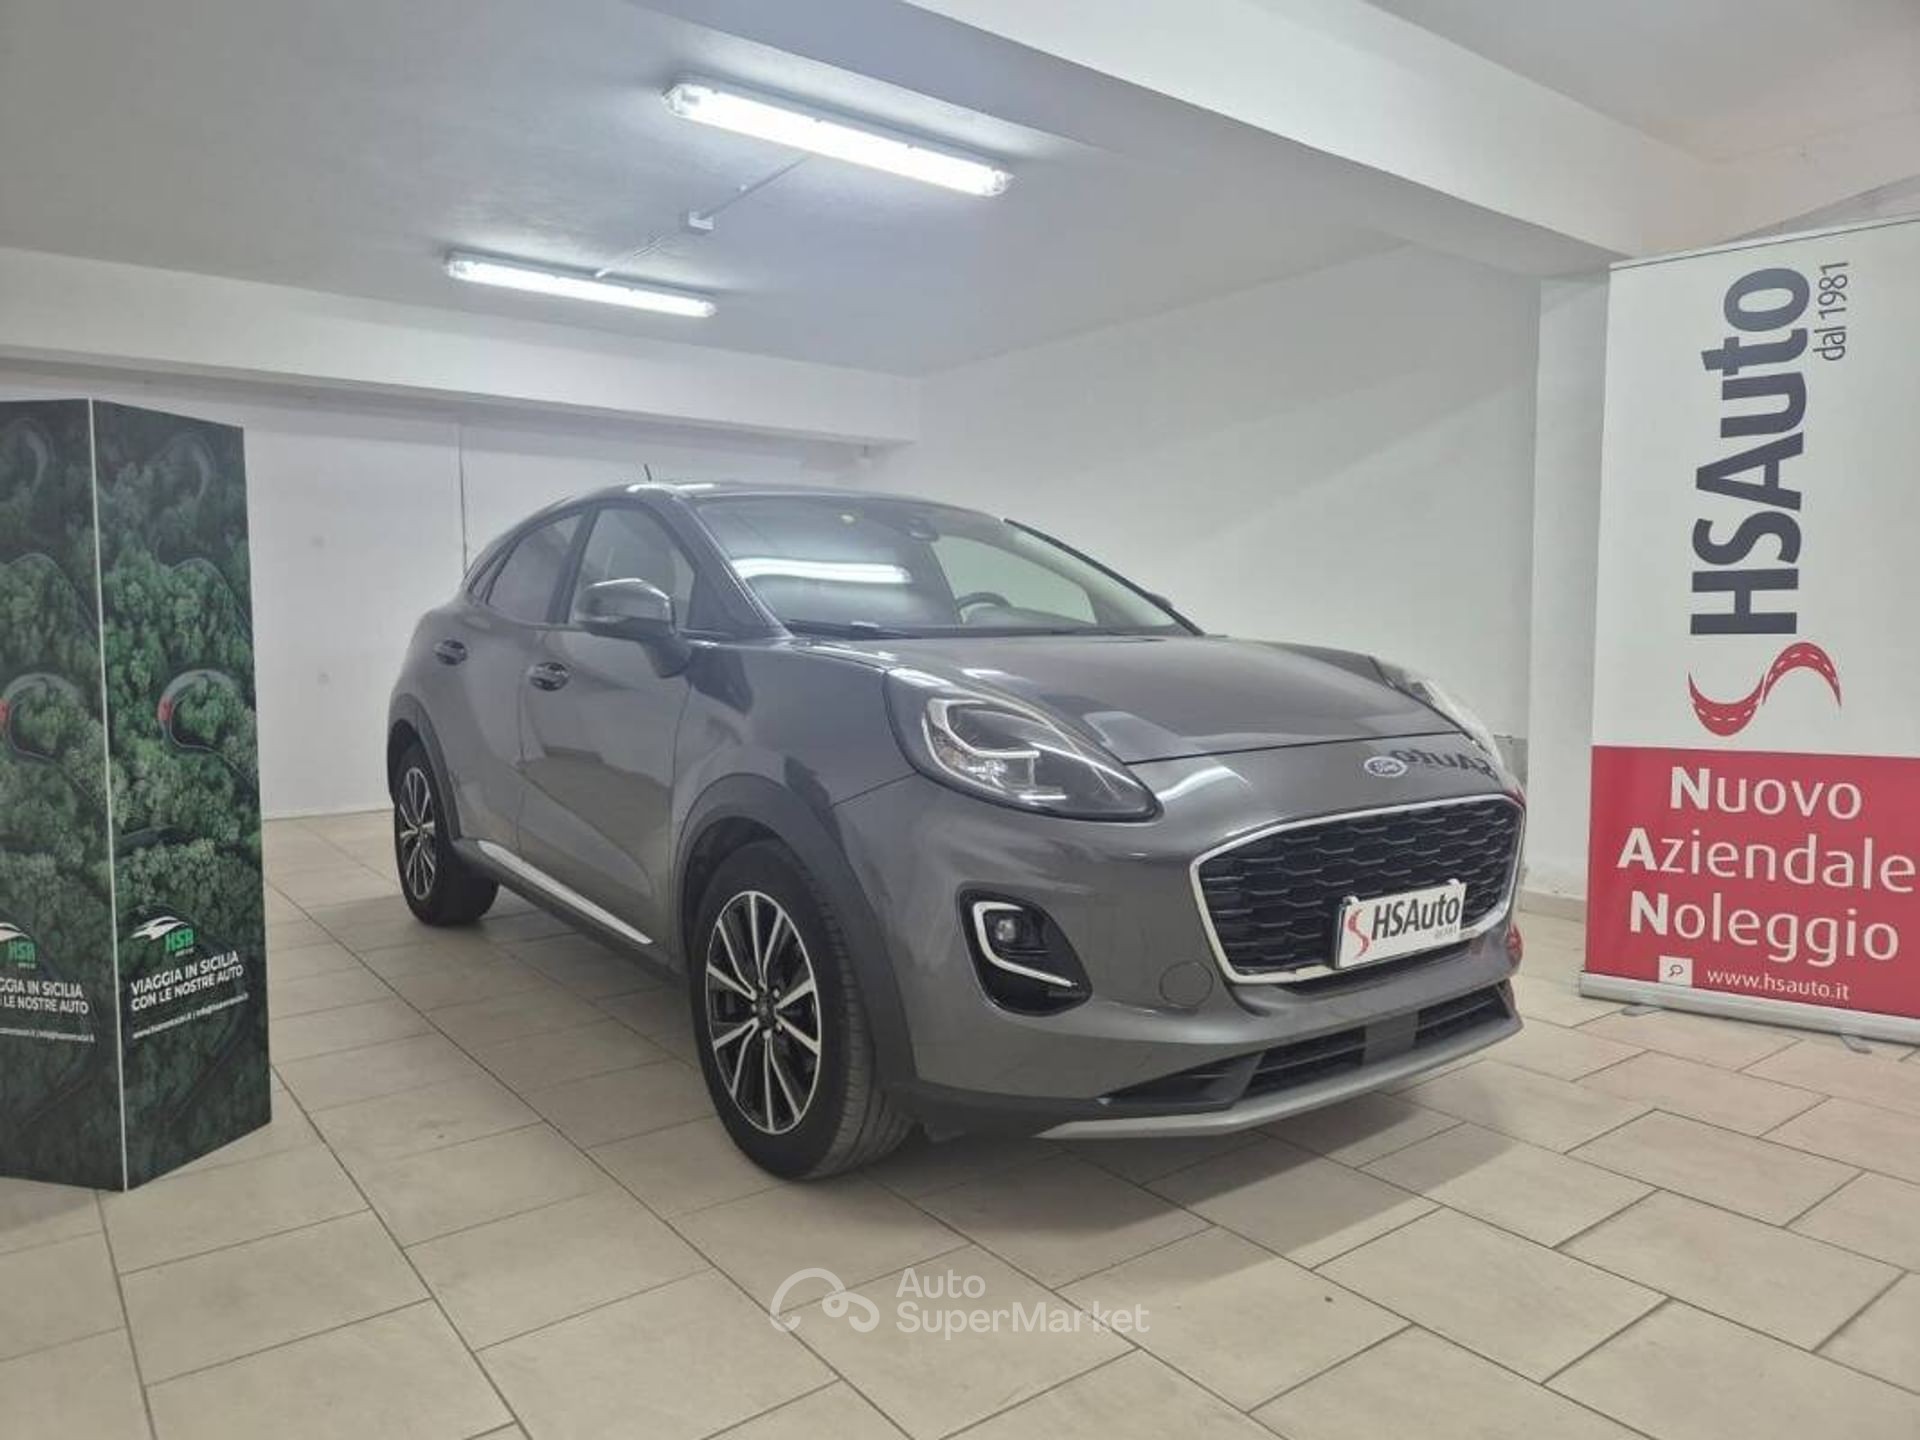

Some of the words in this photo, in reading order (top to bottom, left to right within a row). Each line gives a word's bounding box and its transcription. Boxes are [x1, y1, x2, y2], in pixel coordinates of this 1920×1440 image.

[1819, 261, 1850, 320] 1981
[1813, 327, 1847, 361] dal
[1690, 267, 1811, 635] HSAuto
[1669, 766, 1863, 820] Nuovo
[1616, 827, 1917, 893] Aziendale
[1371, 892, 1460, 941] HSAuto
[1629, 890, 1900, 968] Noleggio
[27, 979, 39, 995] IN
[42, 981, 84, 998] SICILIA
[130, 968, 183, 995] VIAGGIA
[185, 963, 198, 979] IN
[200, 950, 239, 974] SICILIA
[131, 991, 157, 1011] CON
[159, 988, 172, 1002] LE
[174, 974, 215, 998] NOSTRE
[217, 964, 244, 984] AUTO
[1706, 968, 1850, 1001] www.hsauto.it
[3, 994, 16, 1008] LE
[17, 996, 57, 1012] NOSTRE
[60, 999, 90, 1015] AUTO
